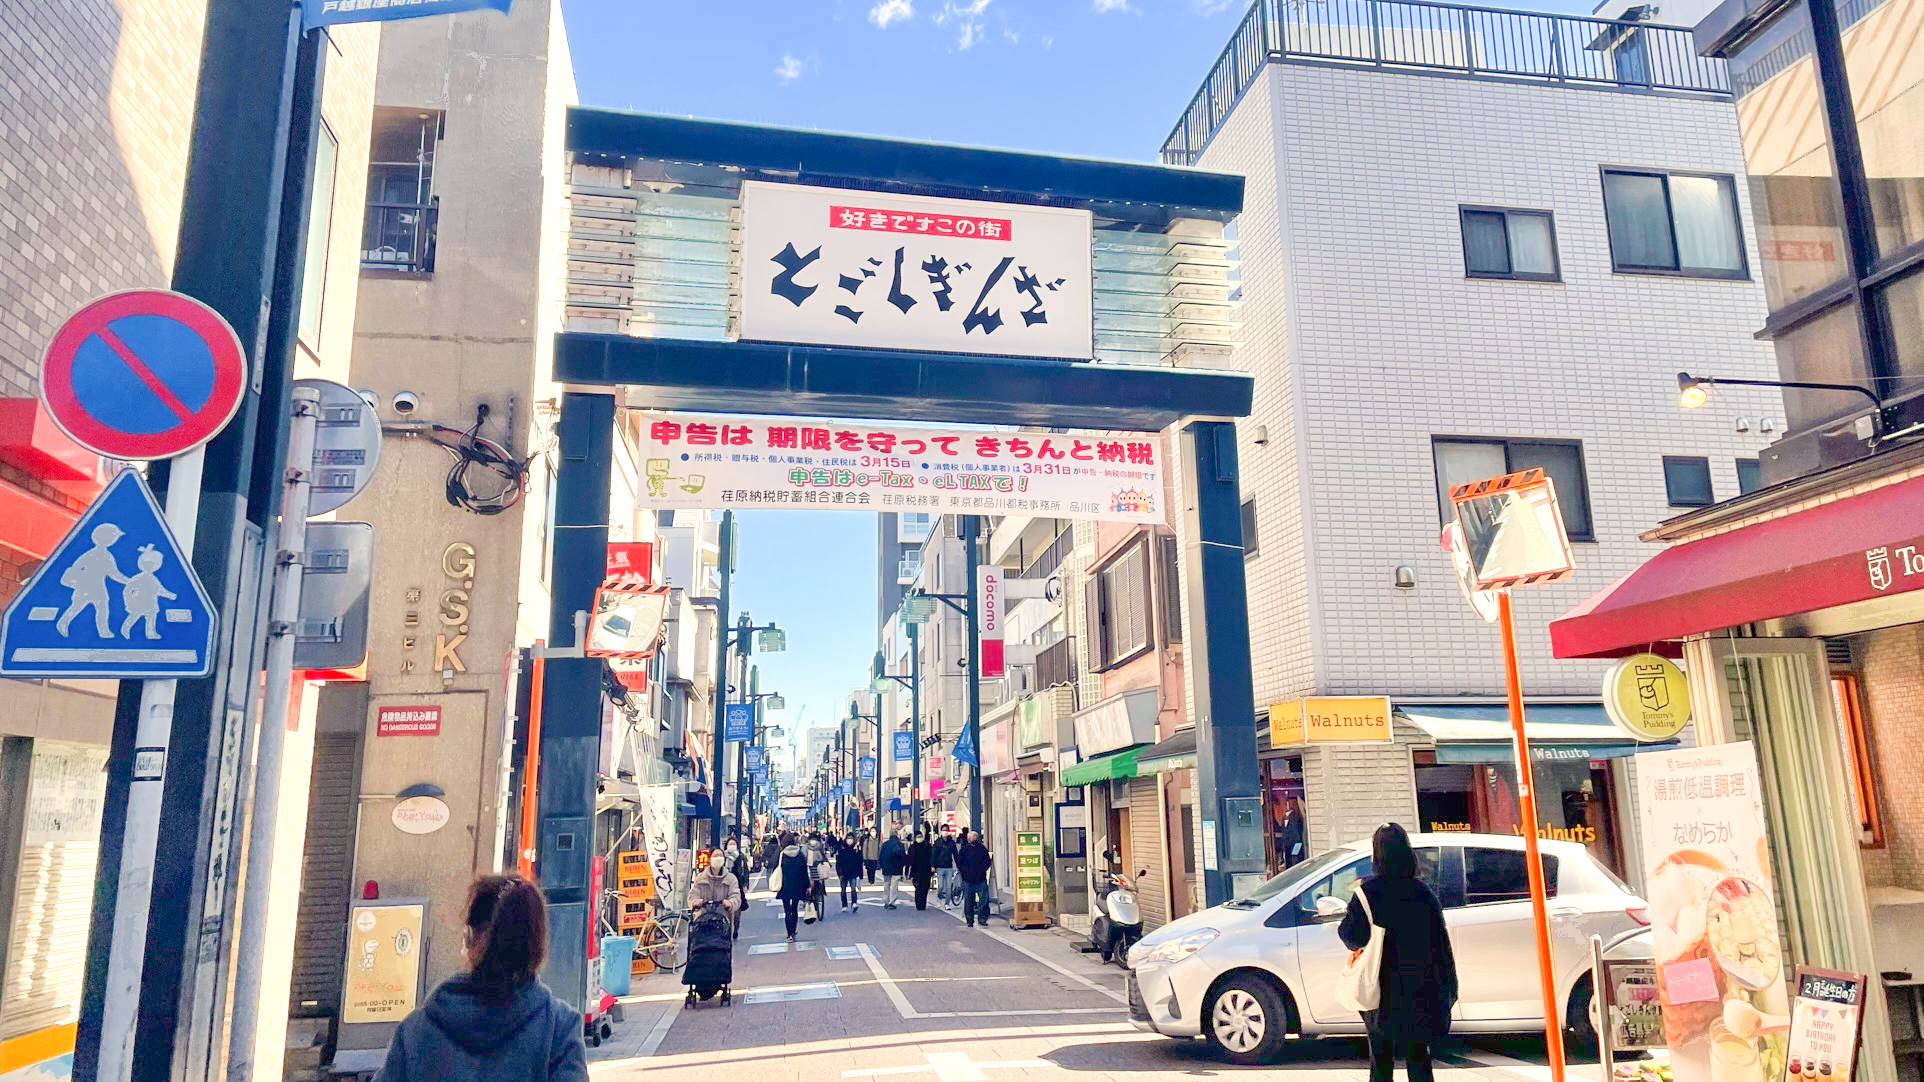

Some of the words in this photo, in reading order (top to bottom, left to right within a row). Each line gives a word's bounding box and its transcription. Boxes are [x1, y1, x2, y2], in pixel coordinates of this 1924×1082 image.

[840, 209, 1002, 238] 好きですこの街
[769, 241, 1067, 335] とごしぎんざ
[650, 420, 753, 446] 申告は
[767, 426, 960, 454] 期限を守って
[975, 436, 1155, 466] きちんと納税
[720, 489, 871, 505] 荏原納税貯蓄組合連合会
[882, 494, 940, 507] 荏原税務署
[949, 496, 1061, 512] 東京都品川都税事務所
[1069, 501, 1100, 514] 品川区
[986, 575, 997, 631] docomo
[1310, 713, 1385, 727] Walnuts
[1642, 711, 1674, 720] Tommy's
[1273, 717, 1302, 731] Walnuts
[1643, 719, 1676, 729] Pudding
[1533, 747, 1590, 759] Walnuts
[1675, 760, 1698, 769] Tommy's
[1698, 758, 1722, 767] Pudding
[1654, 772, 1747, 802] 湯煎低温調理
[1431, 821, 1471, 831] Walnuts
[1673, 821, 1733, 845] なめらか
[624, 864, 646, 872] KIRIN
[1812, 1020, 1834, 1031] HAPPY
[1805, 1029, 1837, 1042] BIRTHDAY
[1810, 1040, 1818, 1051] TO
[1819, 1042, 1832, 1053] YOU
